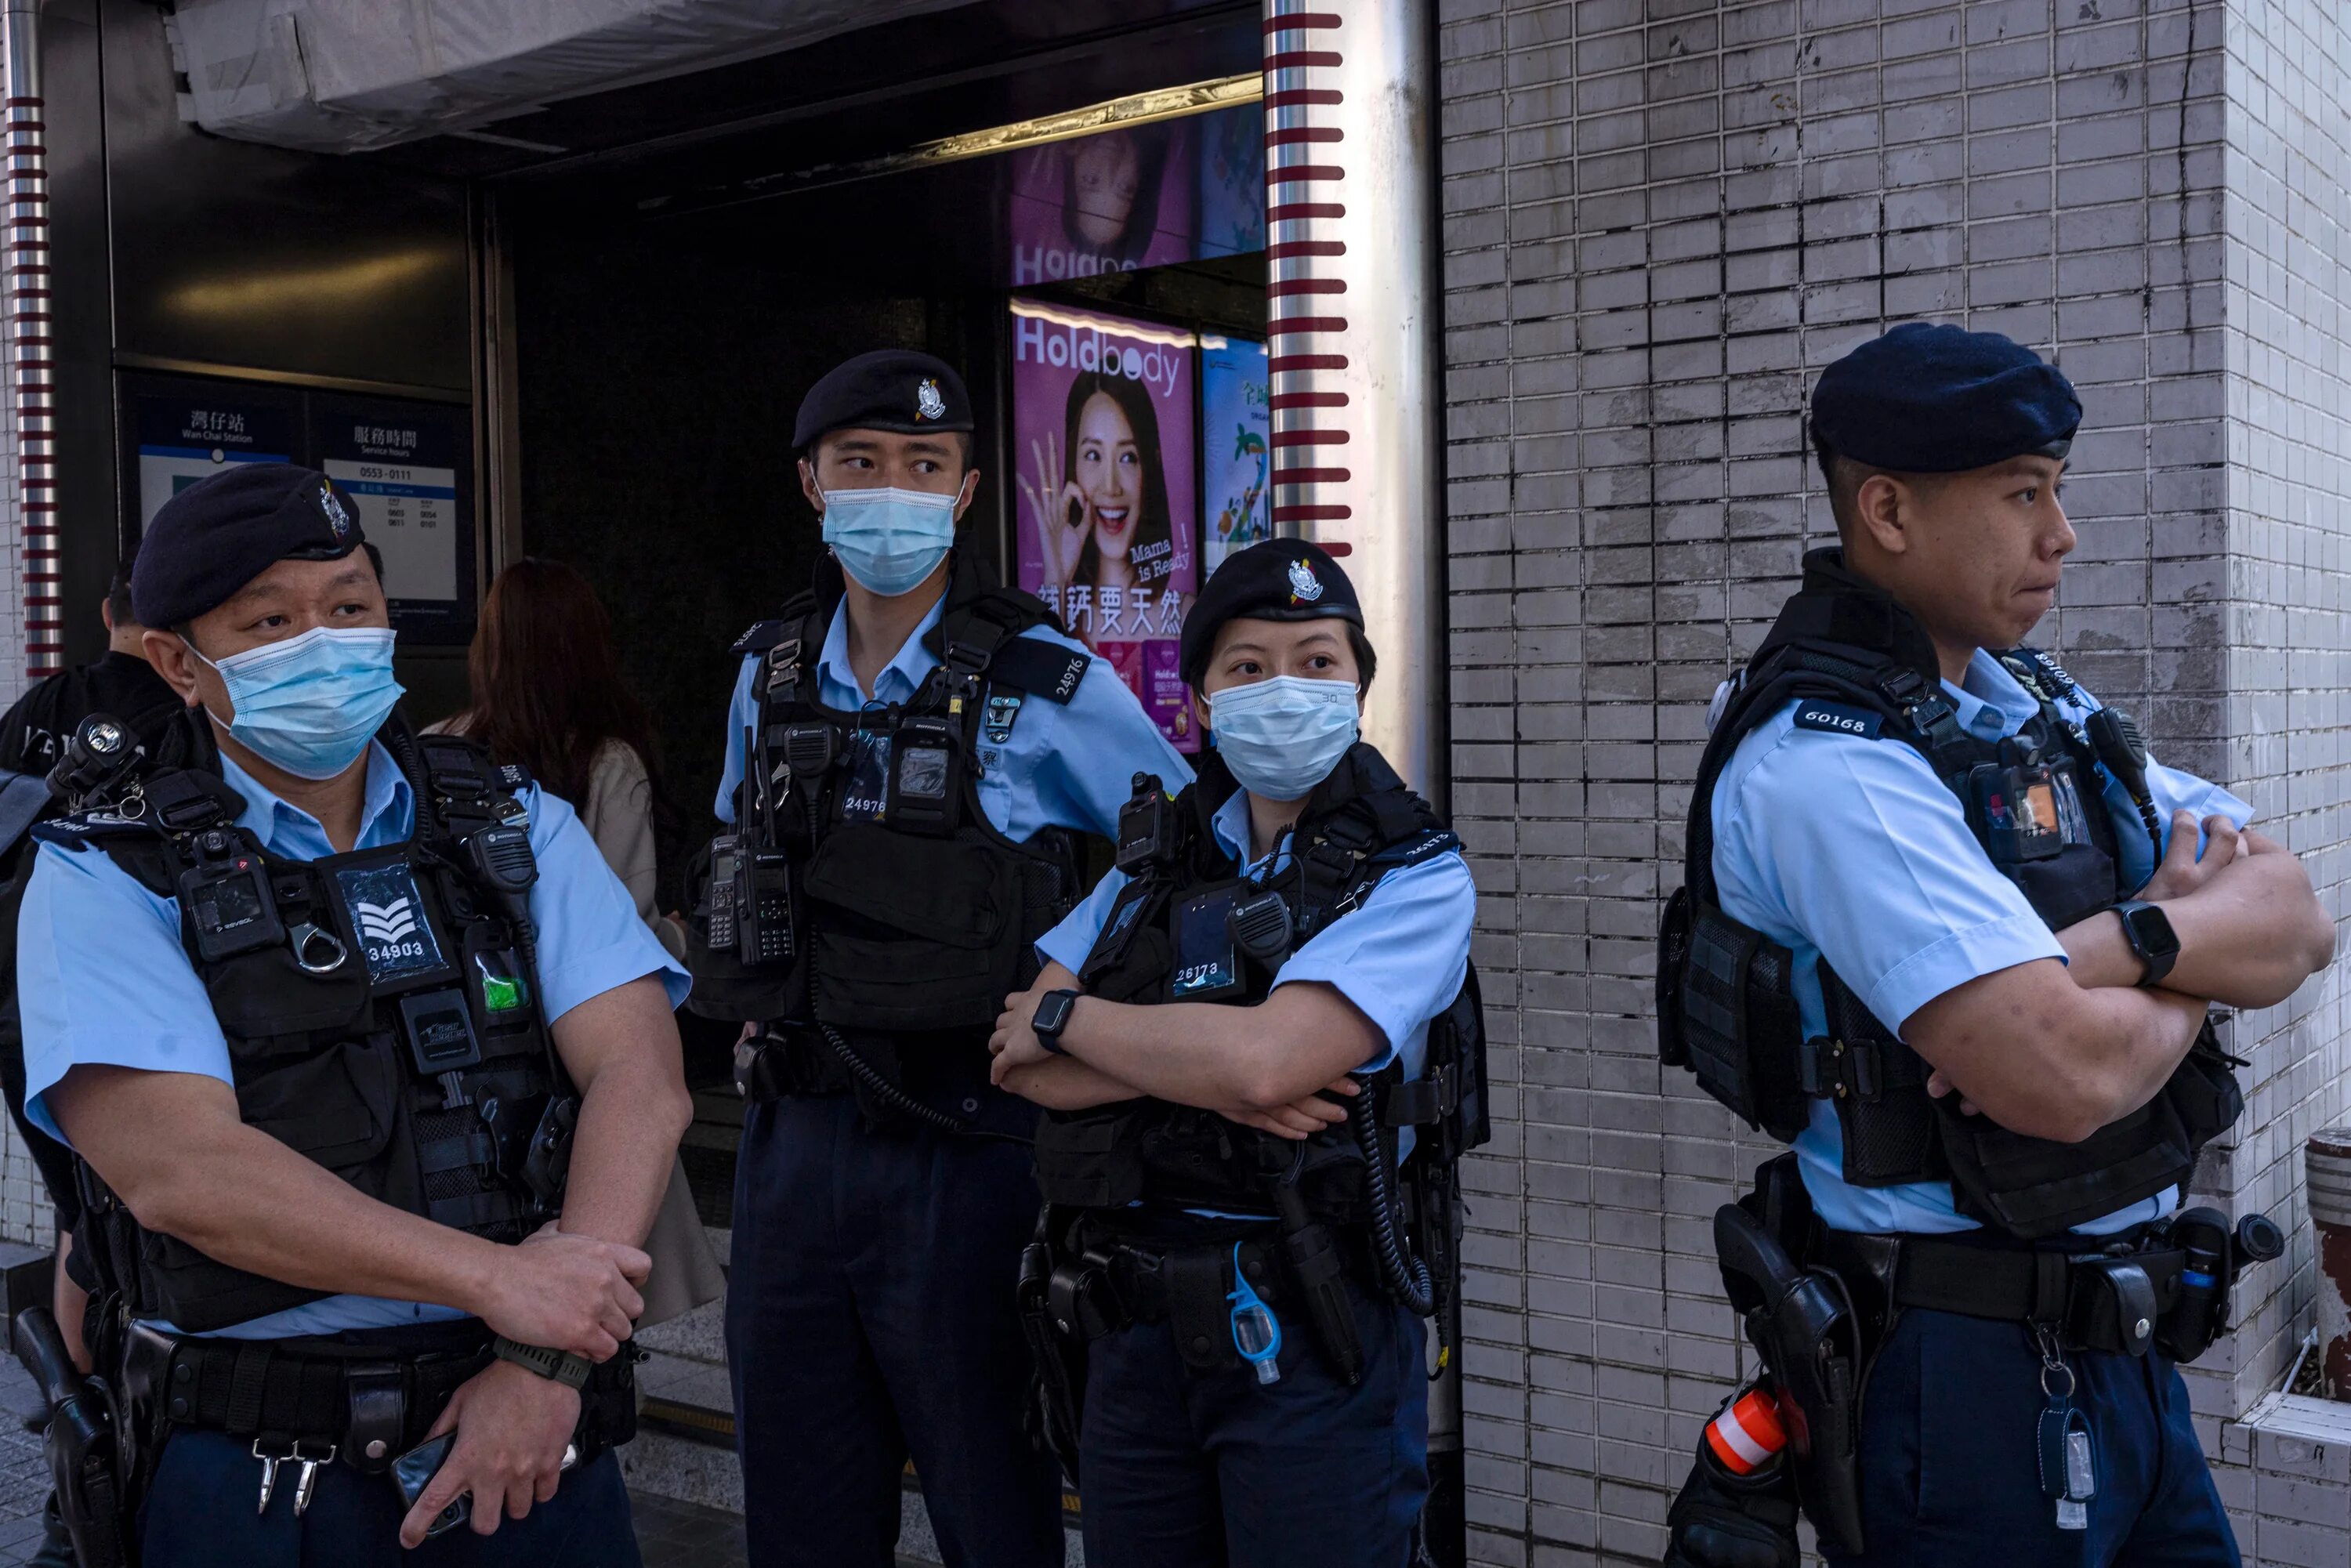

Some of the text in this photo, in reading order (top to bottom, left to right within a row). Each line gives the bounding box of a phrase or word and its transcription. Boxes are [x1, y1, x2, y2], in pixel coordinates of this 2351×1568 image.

[1017, 317, 1179, 397] Holdbody
[190, 409, 245, 433] 灣仔站
[181, 429, 253, 444] Wan Chai Station
[353, 425, 416, 449] 服務時間
[360, 444, 410, 458] Service hours
[1129, 539, 1172, 564] Mama
[1138, 566, 1151, 583] is
[1151, 552, 1190, 578] Ready
[1056, 658, 1083, 696] 24976
[1805, 711, 1865, 733] 60168
[845, 797, 886, 812] 24976
[368, 942, 424, 961] 34903
[1175, 962, 1218, 983] 26173
